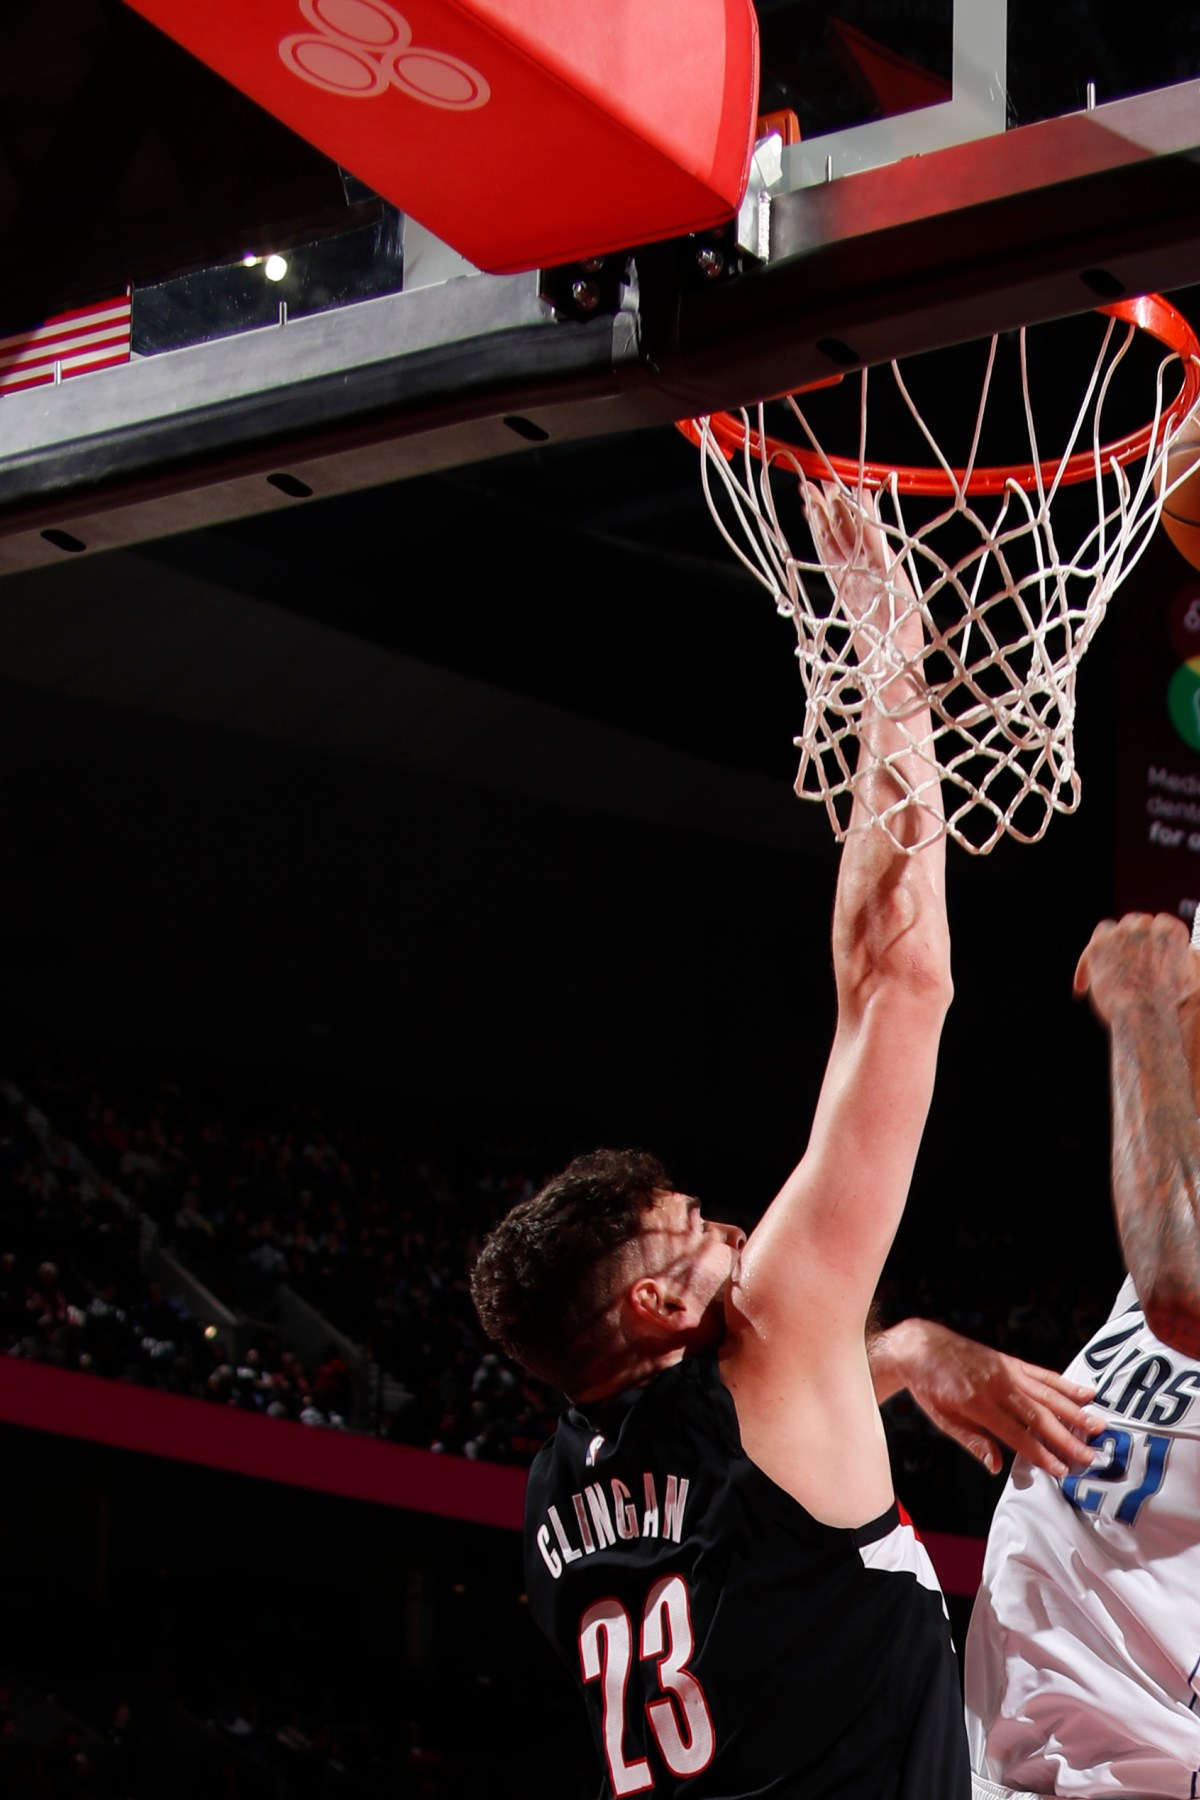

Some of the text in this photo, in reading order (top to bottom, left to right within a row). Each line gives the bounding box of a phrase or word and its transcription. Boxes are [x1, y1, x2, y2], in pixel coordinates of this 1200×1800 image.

[1149, 820, 1185, 847] for
[536, 1472, 690, 1579] CLINGAN
[1062, 1428, 1174, 1527] 21
[579, 1573, 717, 1799] 23
